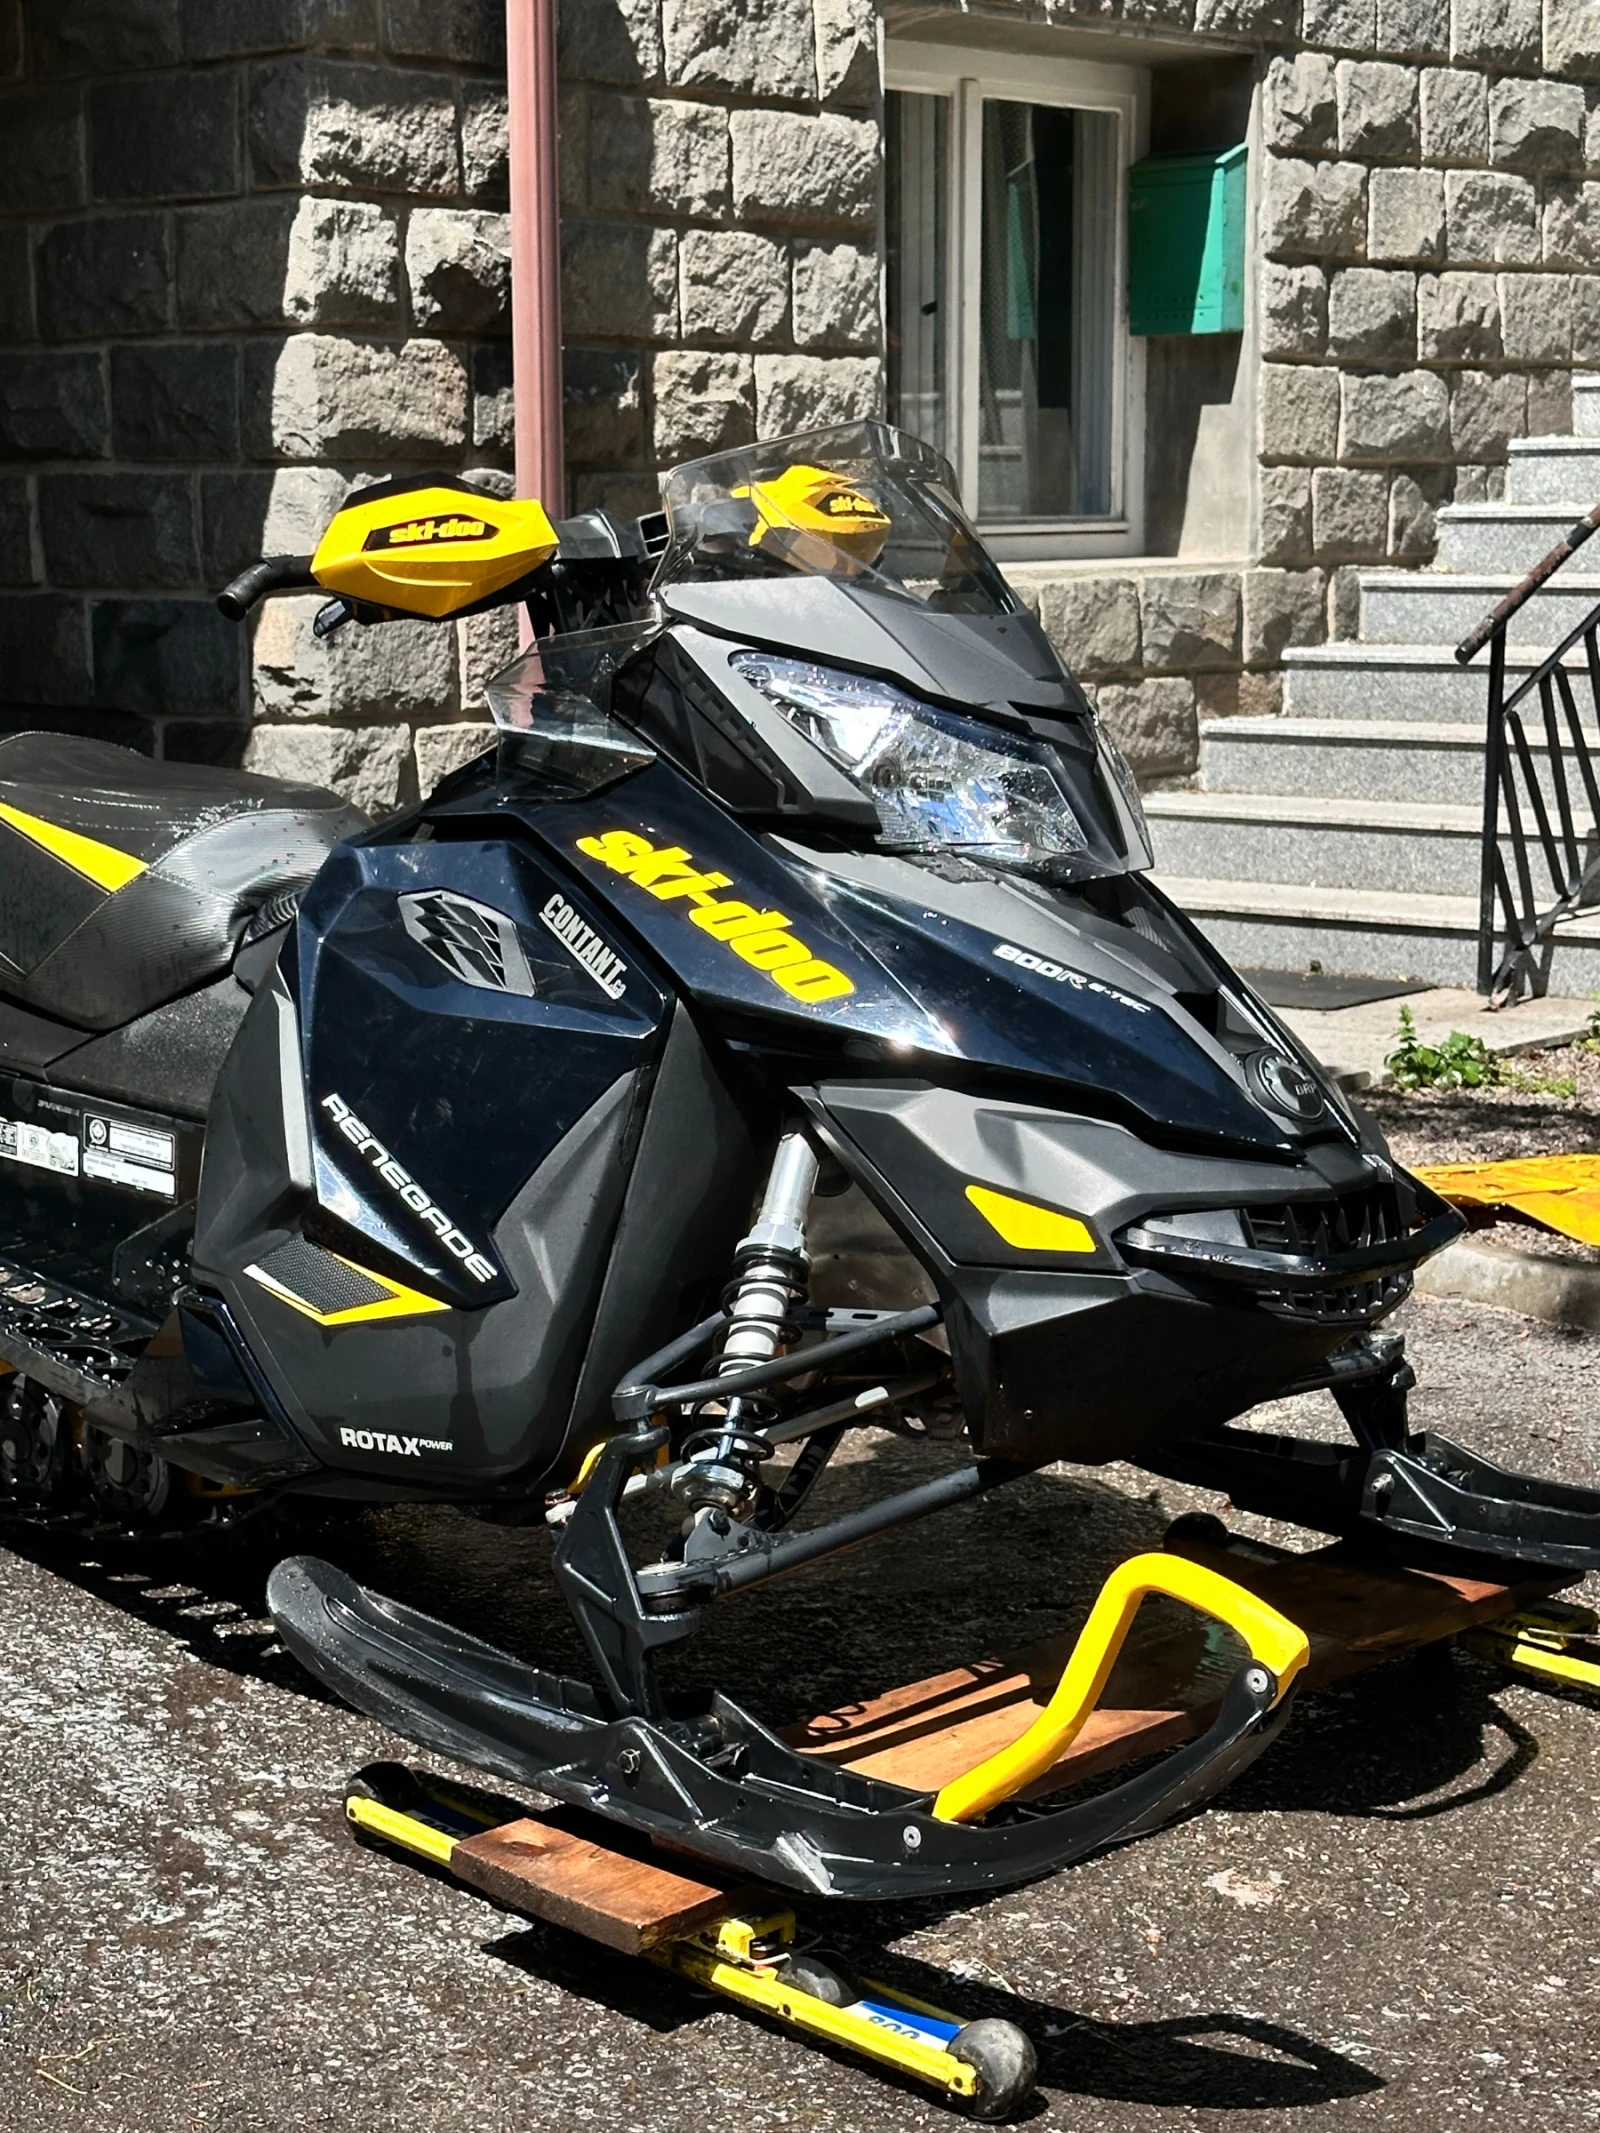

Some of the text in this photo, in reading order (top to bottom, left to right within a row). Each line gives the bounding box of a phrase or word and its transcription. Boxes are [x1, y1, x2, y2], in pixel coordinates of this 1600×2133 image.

[389, 518, 485, 543] ski-doo
[575, 831, 856, 1004] ski-doo
[321, 1093, 498, 1283] RENEGADE
[340, 1427, 453, 1457] ROTAX POWER
